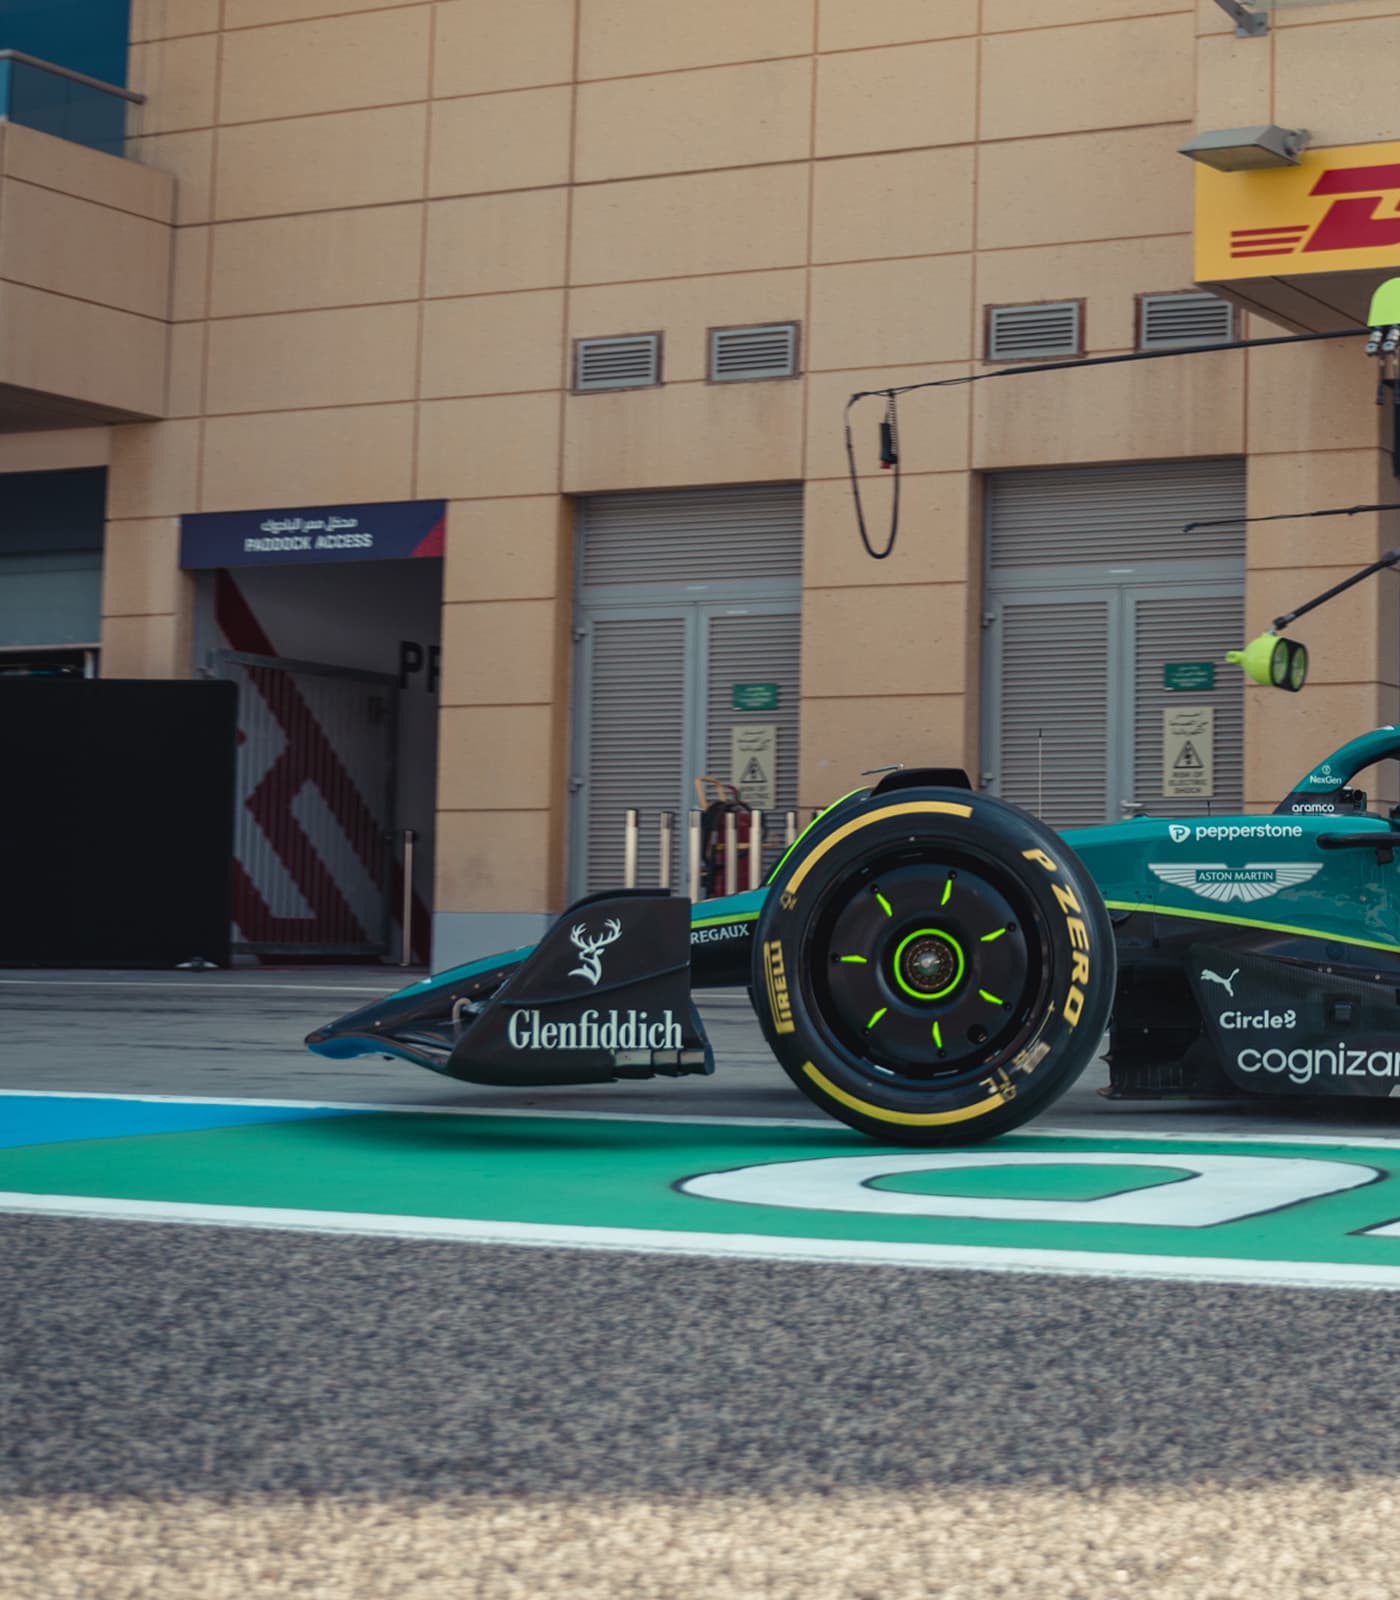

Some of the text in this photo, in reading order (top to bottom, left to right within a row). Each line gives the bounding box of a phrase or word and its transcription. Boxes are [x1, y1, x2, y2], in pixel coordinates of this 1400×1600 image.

[244, 533, 374, 553] PADDOCK ACCESS
[1309, 775, 1342, 785] NexGen
[1292, 803, 1335, 813] aramco
[1195, 823, 1303, 841] pepperstone
[1198, 869, 1274, 883] ASTON MARTIN
[1021, 847, 1090, 1029] P ZERO
[763, 939, 796, 1035] PIRELLI
[508, 1008, 684, 1050] Glenfiddich
